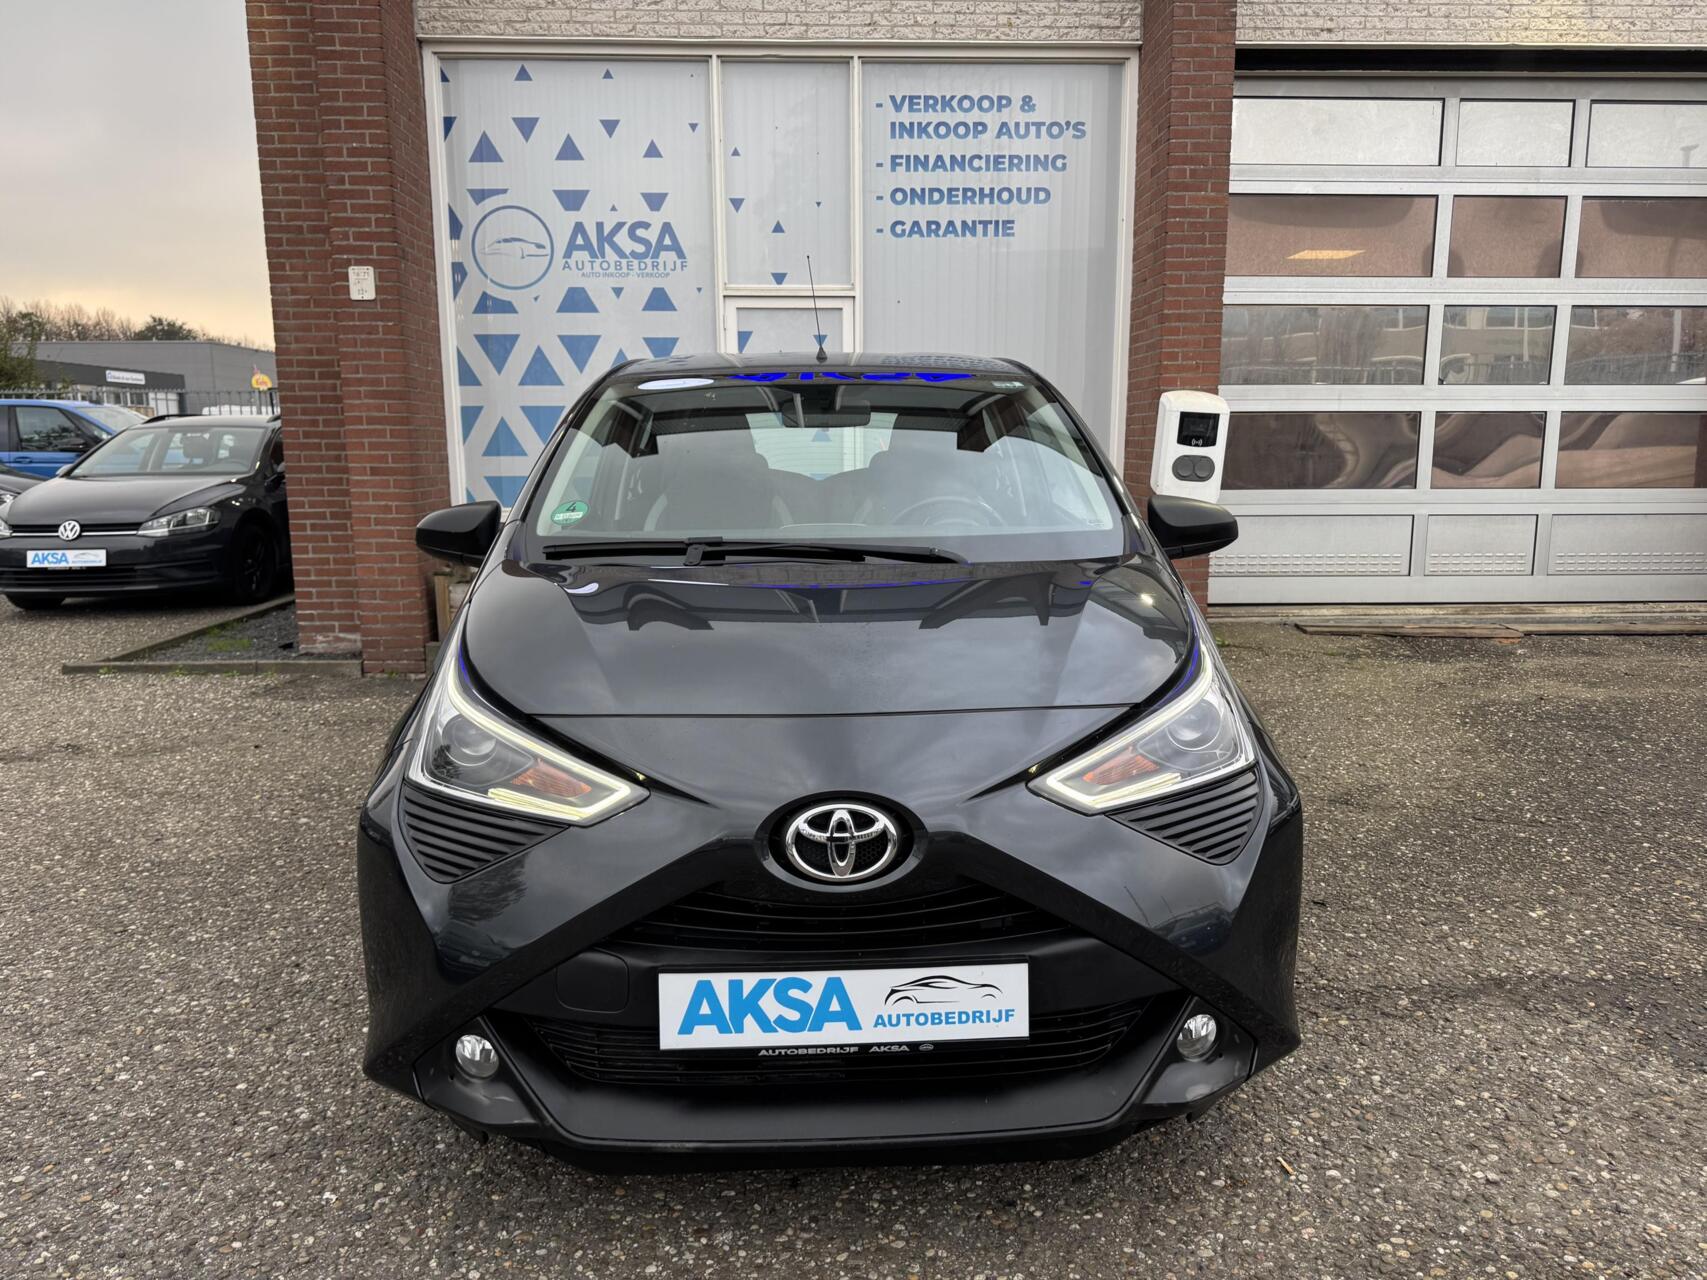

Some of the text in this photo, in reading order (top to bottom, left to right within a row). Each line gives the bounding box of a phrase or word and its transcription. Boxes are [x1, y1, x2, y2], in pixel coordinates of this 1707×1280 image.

[889, 95, 1012, 113] VERKOOP
[1019, 95, 1036, 113] &
[890, 121, 1087, 140] INKOOP AUTO'S
[890, 154, 1067, 172] FINANCIERING
[890, 187, 1051, 205] ONDERHOUD
[890, 219, 1015, 238] GARANTIE
[562, 221, 687, 260] AKSA
[562, 260, 688, 271] AUTOBEDRIJF
[566, 502, 577, 512] 4
[31, 552, 69, 565] AKSA
[677, 976, 863, 1035] AKSA
[873, 1008, 1015, 1028] AUTOBEDRIJF
[758, 1046, 859, 1056] AUTOBEDRIJF
